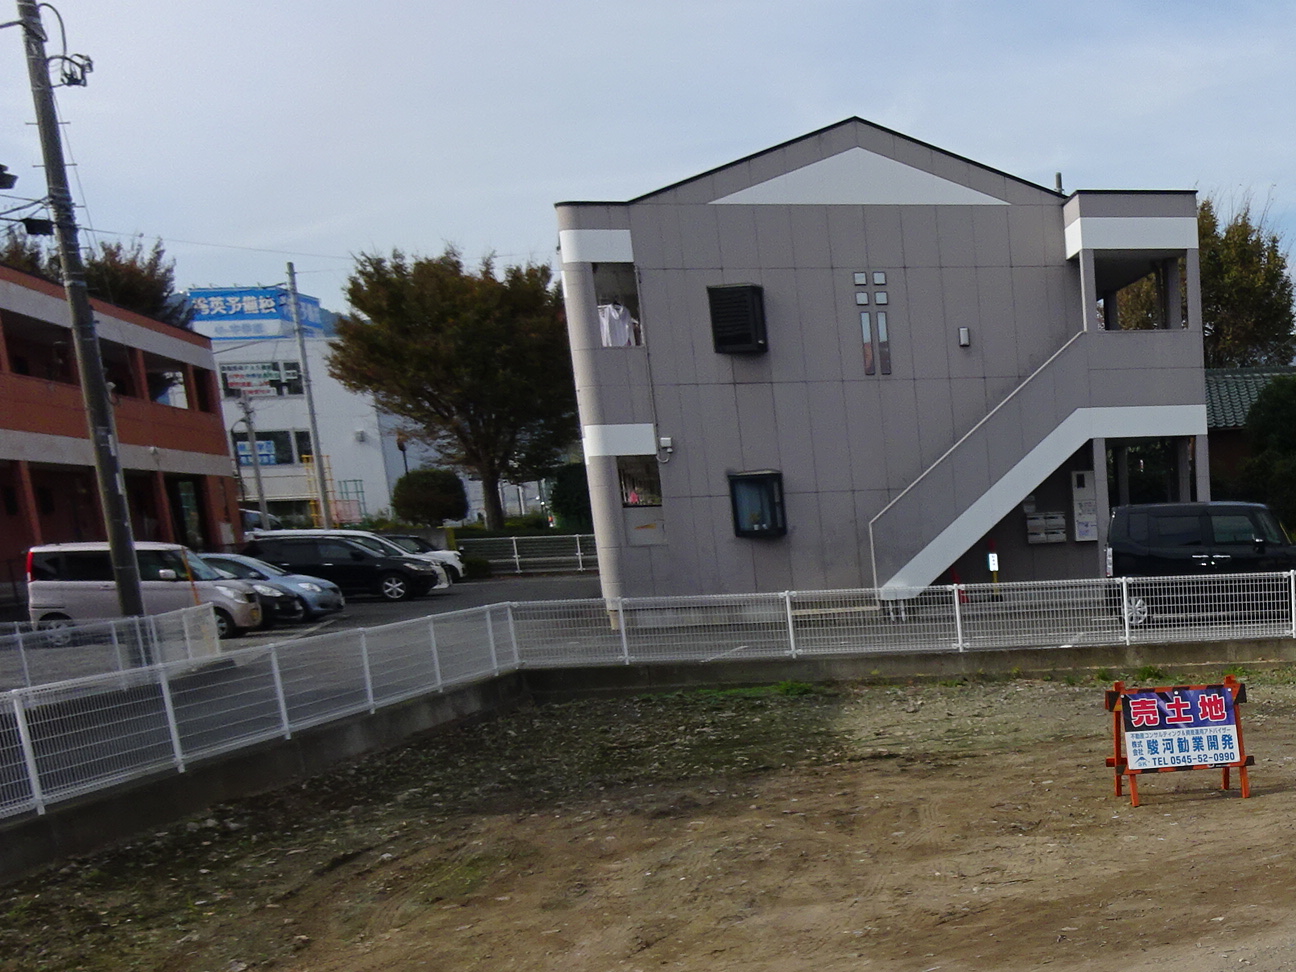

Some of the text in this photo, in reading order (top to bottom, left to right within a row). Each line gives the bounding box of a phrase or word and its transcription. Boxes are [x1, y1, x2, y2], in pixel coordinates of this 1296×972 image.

[1130, 694, 1226, 727] 売土地
[1146, 734, 1234, 756] 駿河勧業開発
[1152, 751, 1235, 767] TEL 0545-52-0990
